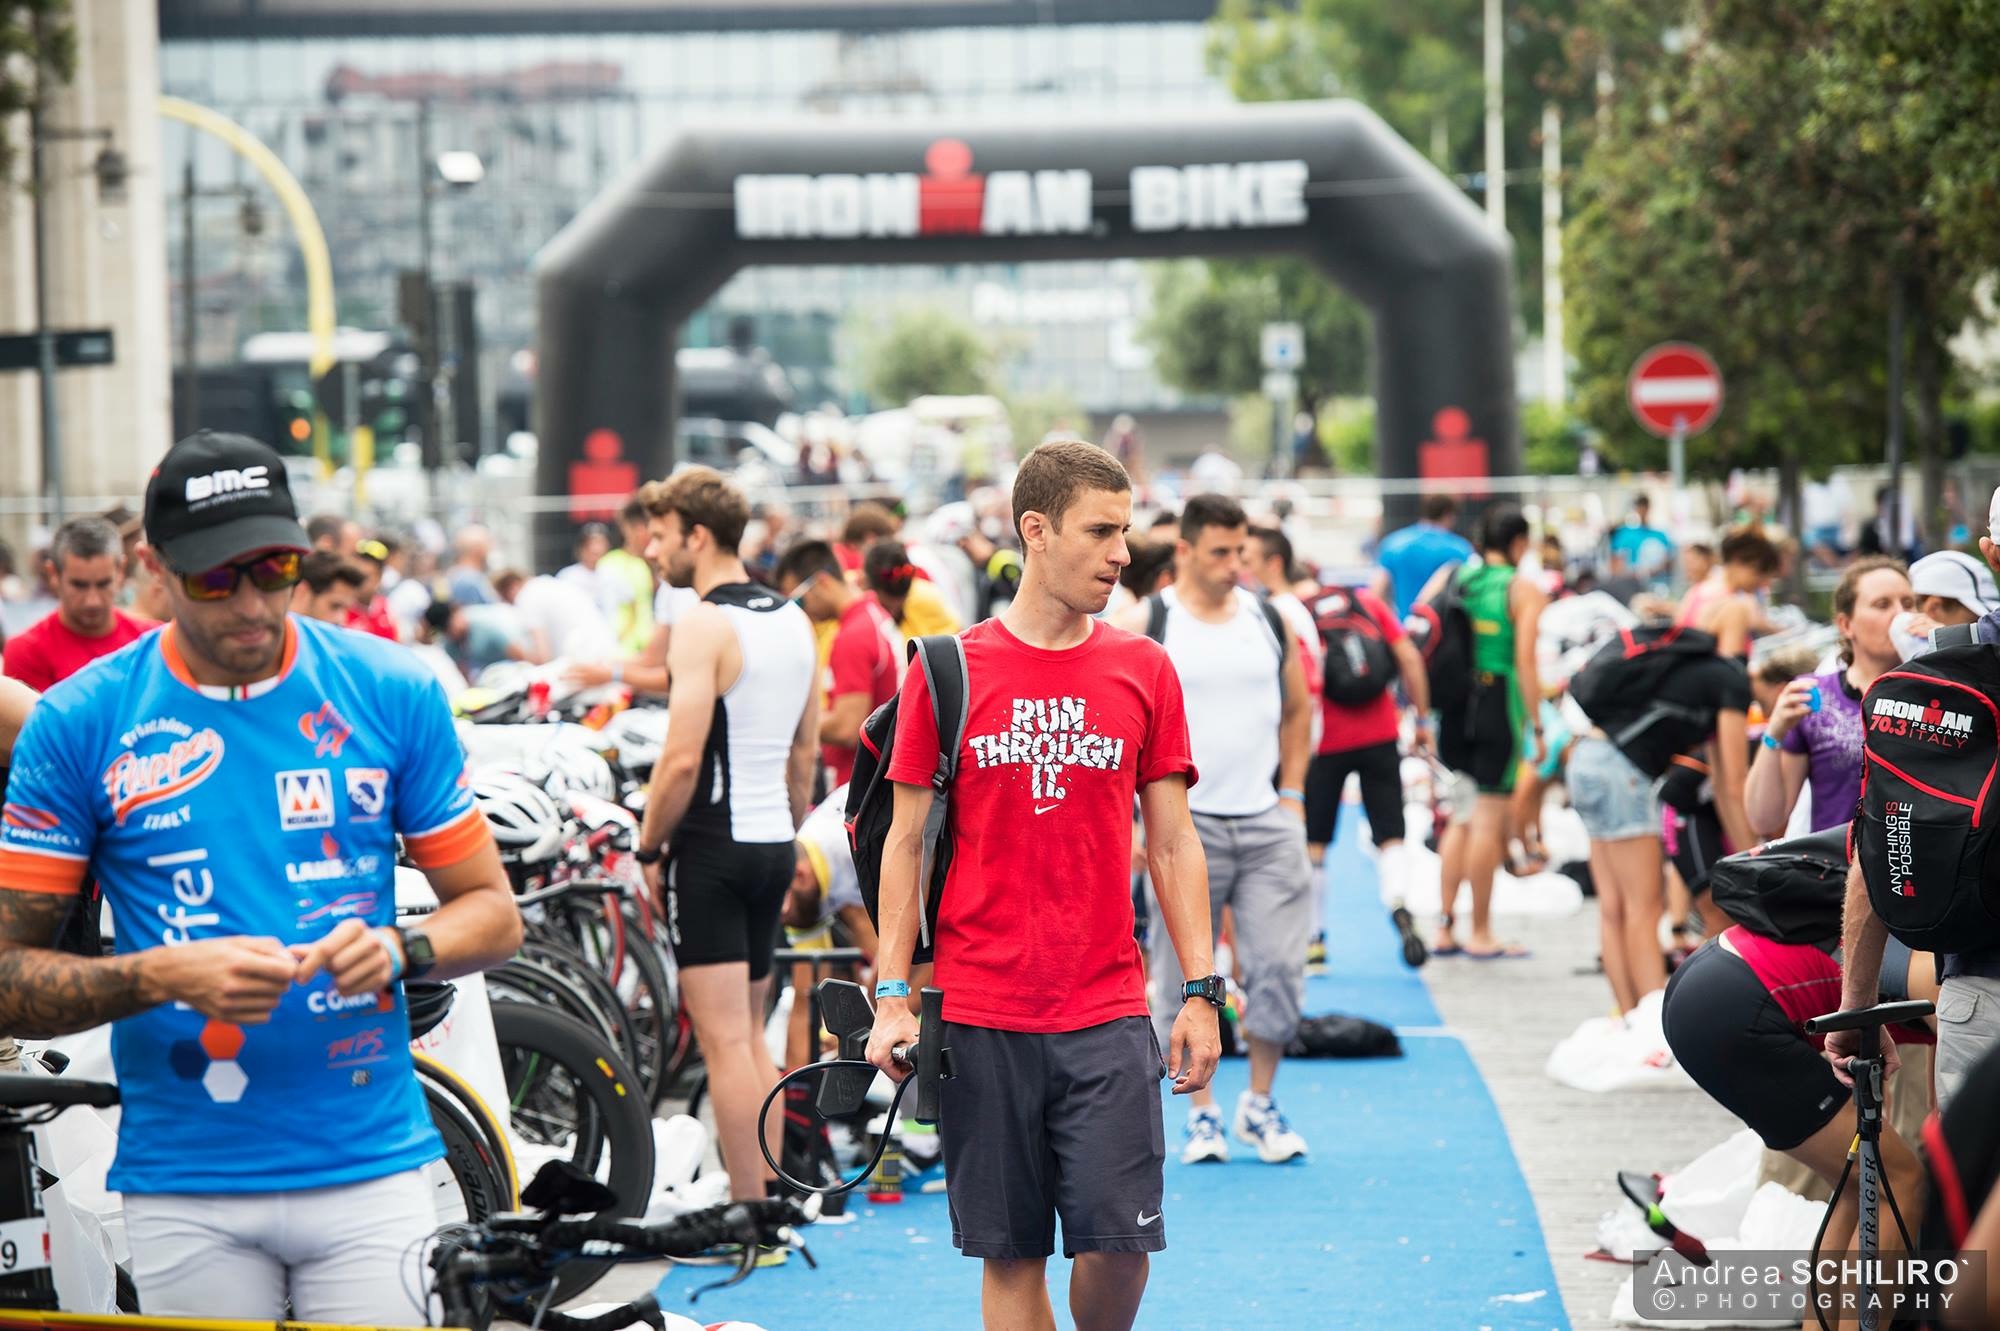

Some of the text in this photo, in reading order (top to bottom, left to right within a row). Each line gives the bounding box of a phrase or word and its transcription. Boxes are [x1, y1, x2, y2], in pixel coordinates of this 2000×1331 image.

[1129, 159, 1309, 233] BIKE
[1010, 696, 1087, 733] RUN
[1869, 715, 1969, 739] 70.3 PESCARA
[1872, 698, 1973, 733] IRONMAN
[968, 731, 1125, 771] THROUGH
[1909, 728, 1968, 749] ITALY
[143, 804, 191, 830] ITALY
[1898, 802, 1913, 876] POSSIBLE
